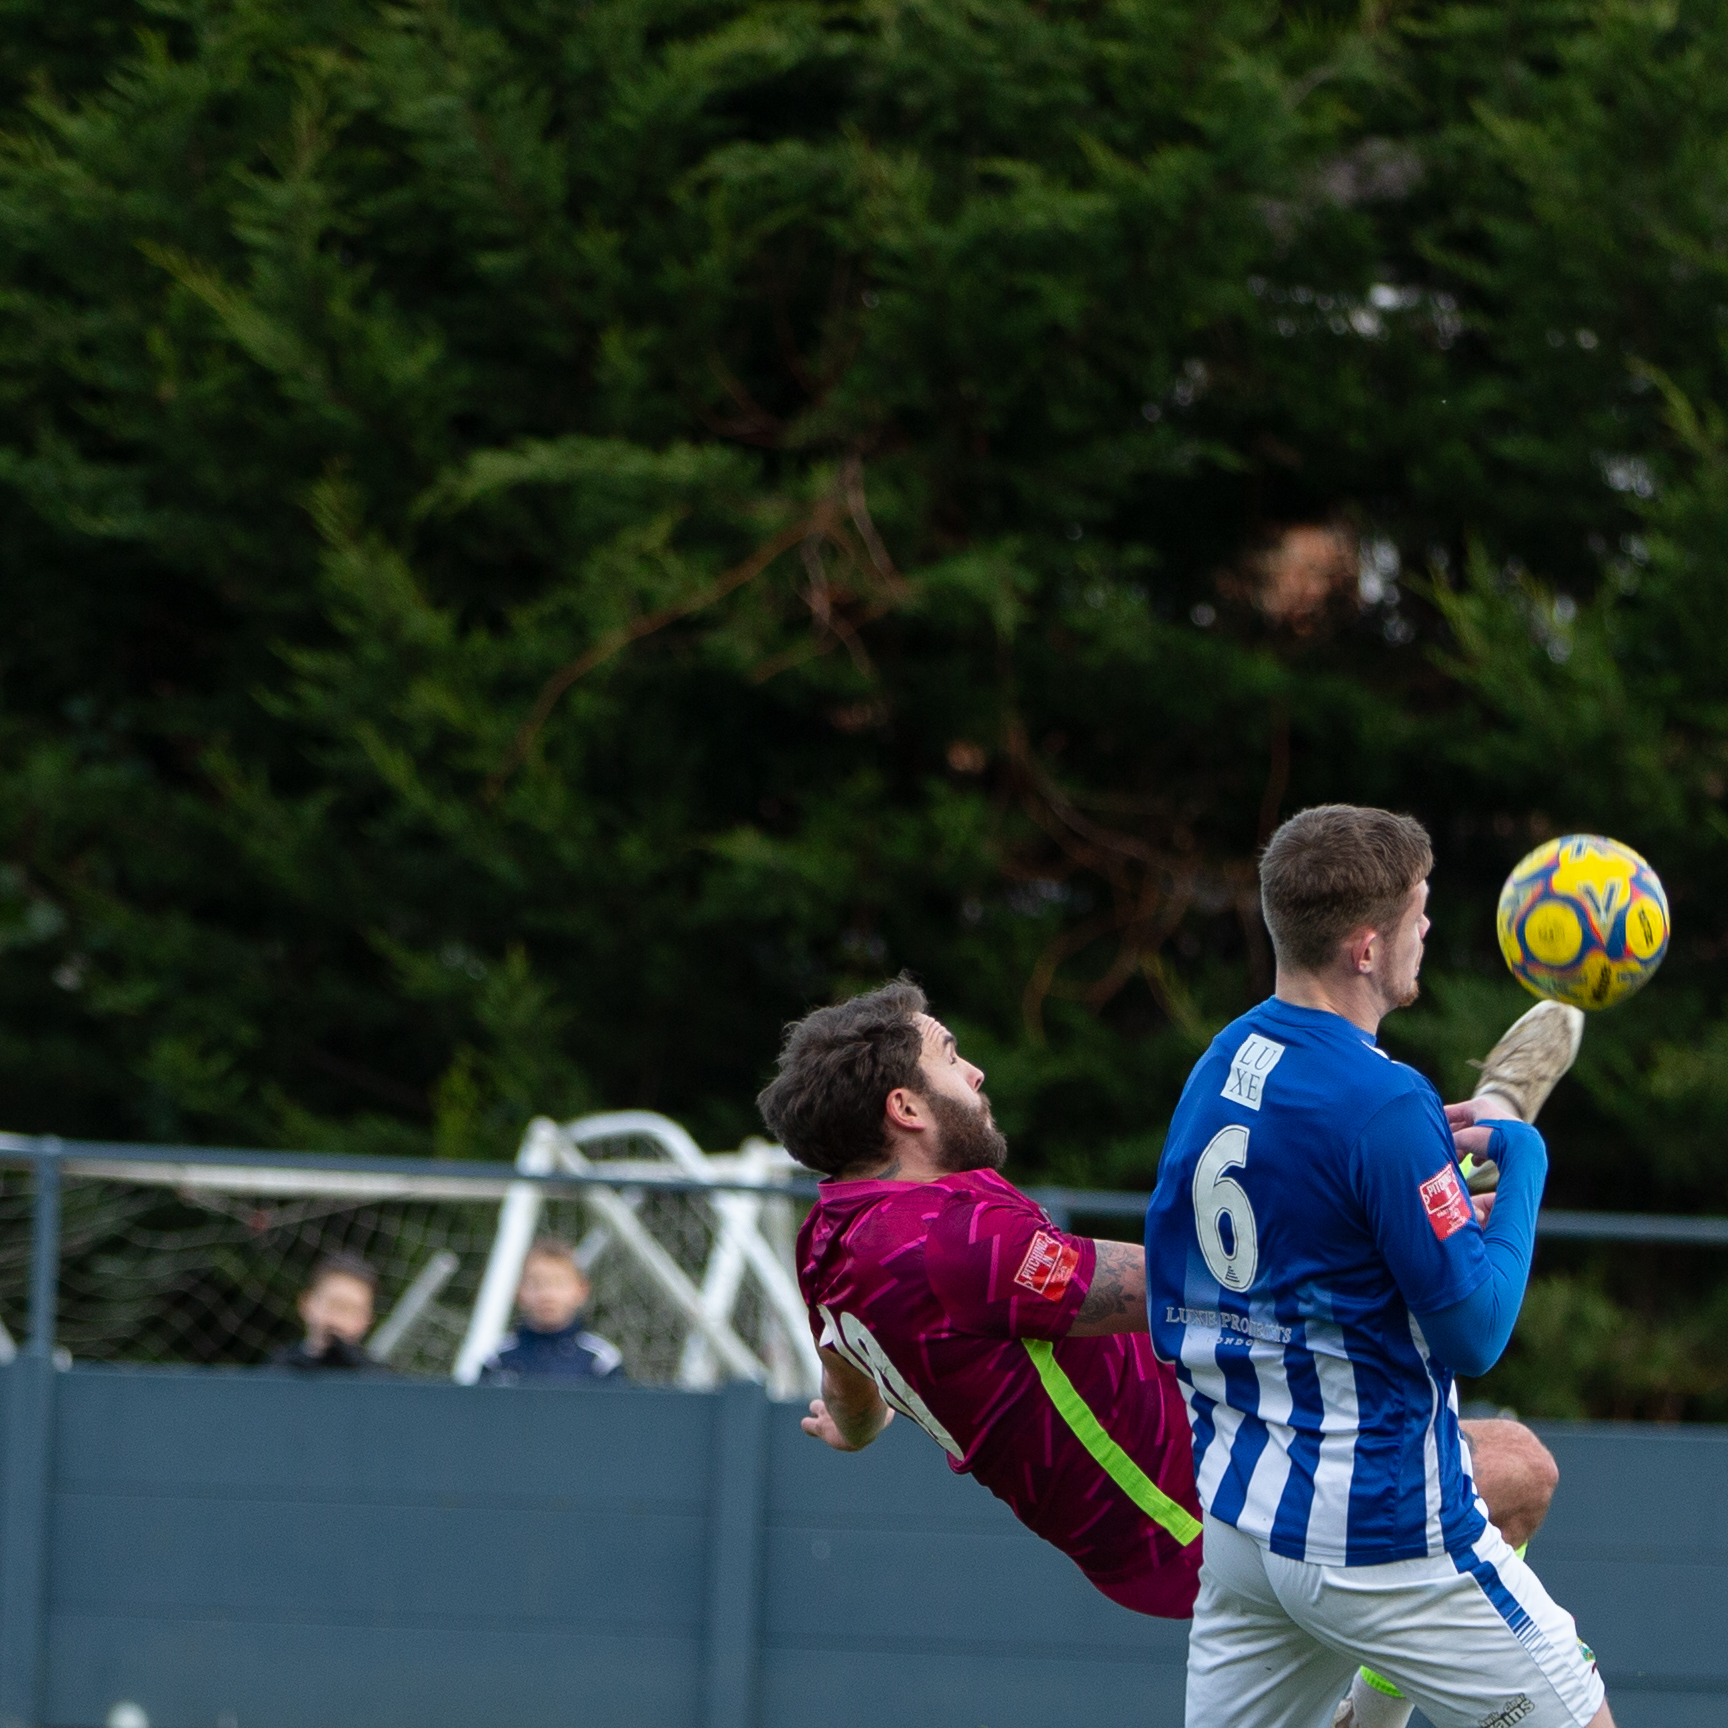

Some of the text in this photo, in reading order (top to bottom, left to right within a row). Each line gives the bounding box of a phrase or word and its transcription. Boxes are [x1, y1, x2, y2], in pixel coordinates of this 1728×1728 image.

[1239, 1040, 1277, 1072] LU
[1229, 1067, 1261, 1102] XE
[1192, 1123, 1259, 1293] 6
[1165, 1306, 1219, 1328] LUXE
